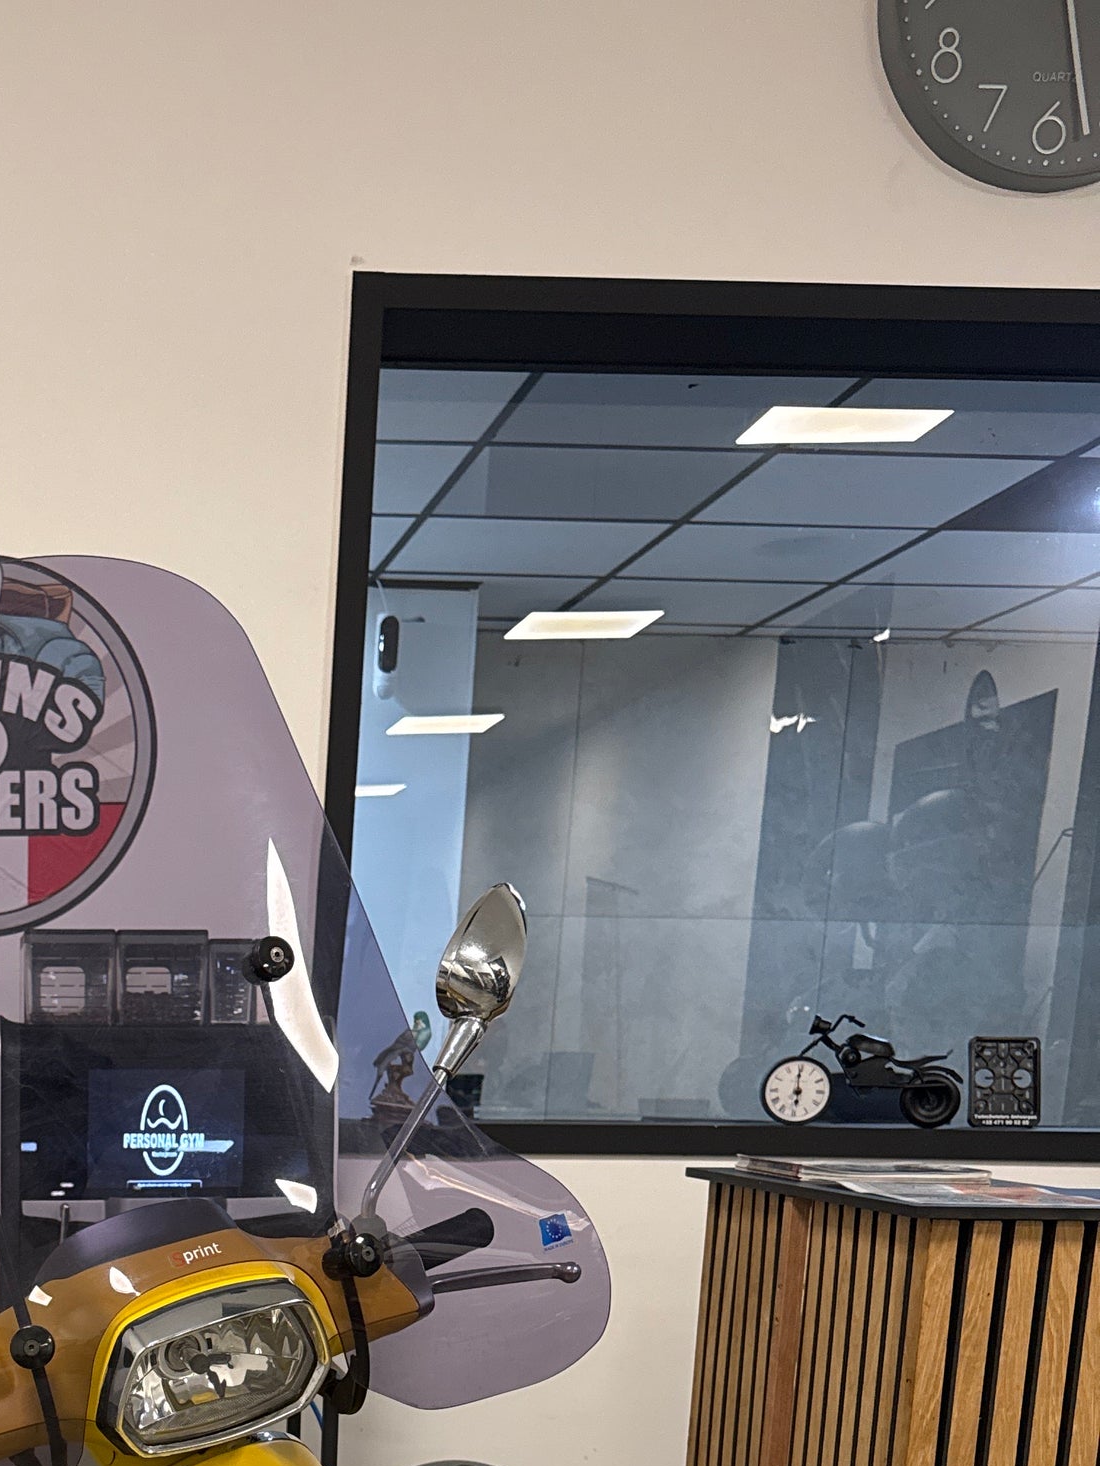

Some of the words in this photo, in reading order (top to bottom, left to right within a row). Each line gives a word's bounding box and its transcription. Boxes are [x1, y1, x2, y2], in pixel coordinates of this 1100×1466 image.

[931, 27, 962, 83] 8
[1032, 71, 1077, 82] QUART
[978, 84, 1008, 132] 7
[1032, 101, 1066, 154] 6
[123, 1132, 179, 1149] PERSONAL
[180, 1132, 205, 1149] GYM
